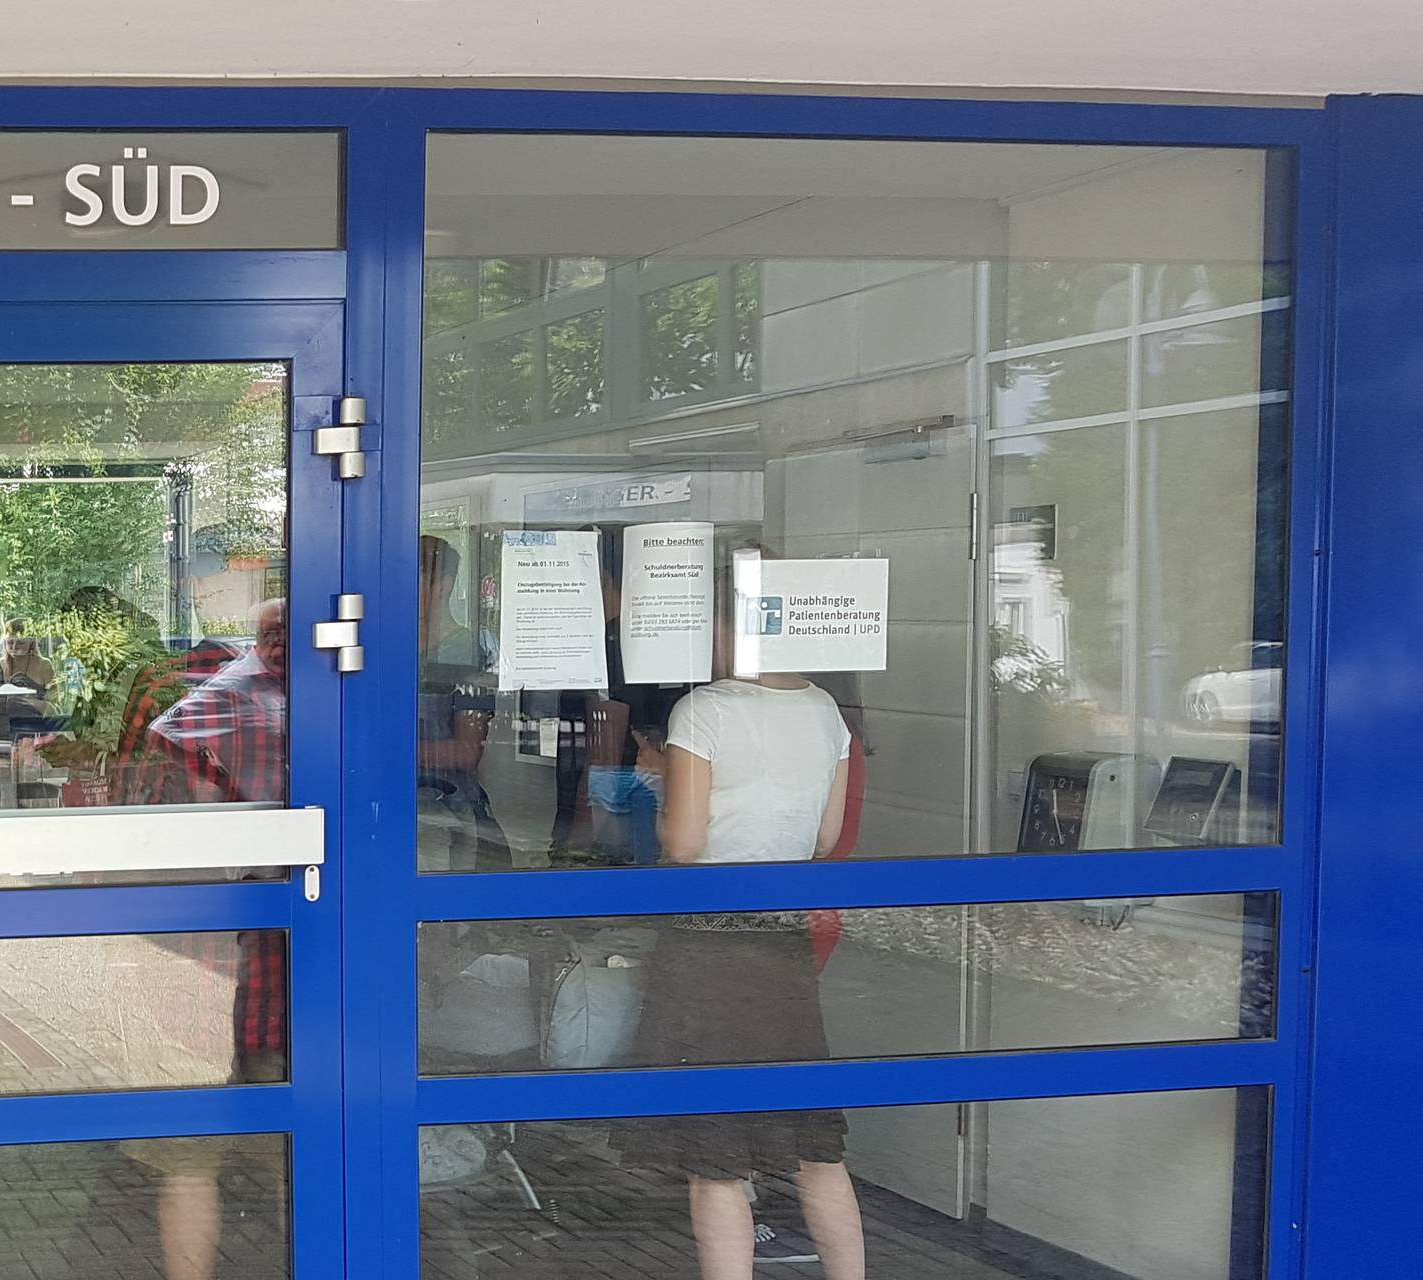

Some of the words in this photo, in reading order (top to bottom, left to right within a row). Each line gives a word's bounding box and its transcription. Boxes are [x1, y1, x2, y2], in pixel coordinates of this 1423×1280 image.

[64, 147, 220, 227] SÜD
[643, 537, 664, 547] Bitte
[789, 596, 855, 608] Unabhängige
[789, 610, 880, 621] Patientenberatung
[789, 624, 850, 635] Deutschland
[860, 623, 880, 634] UPD
